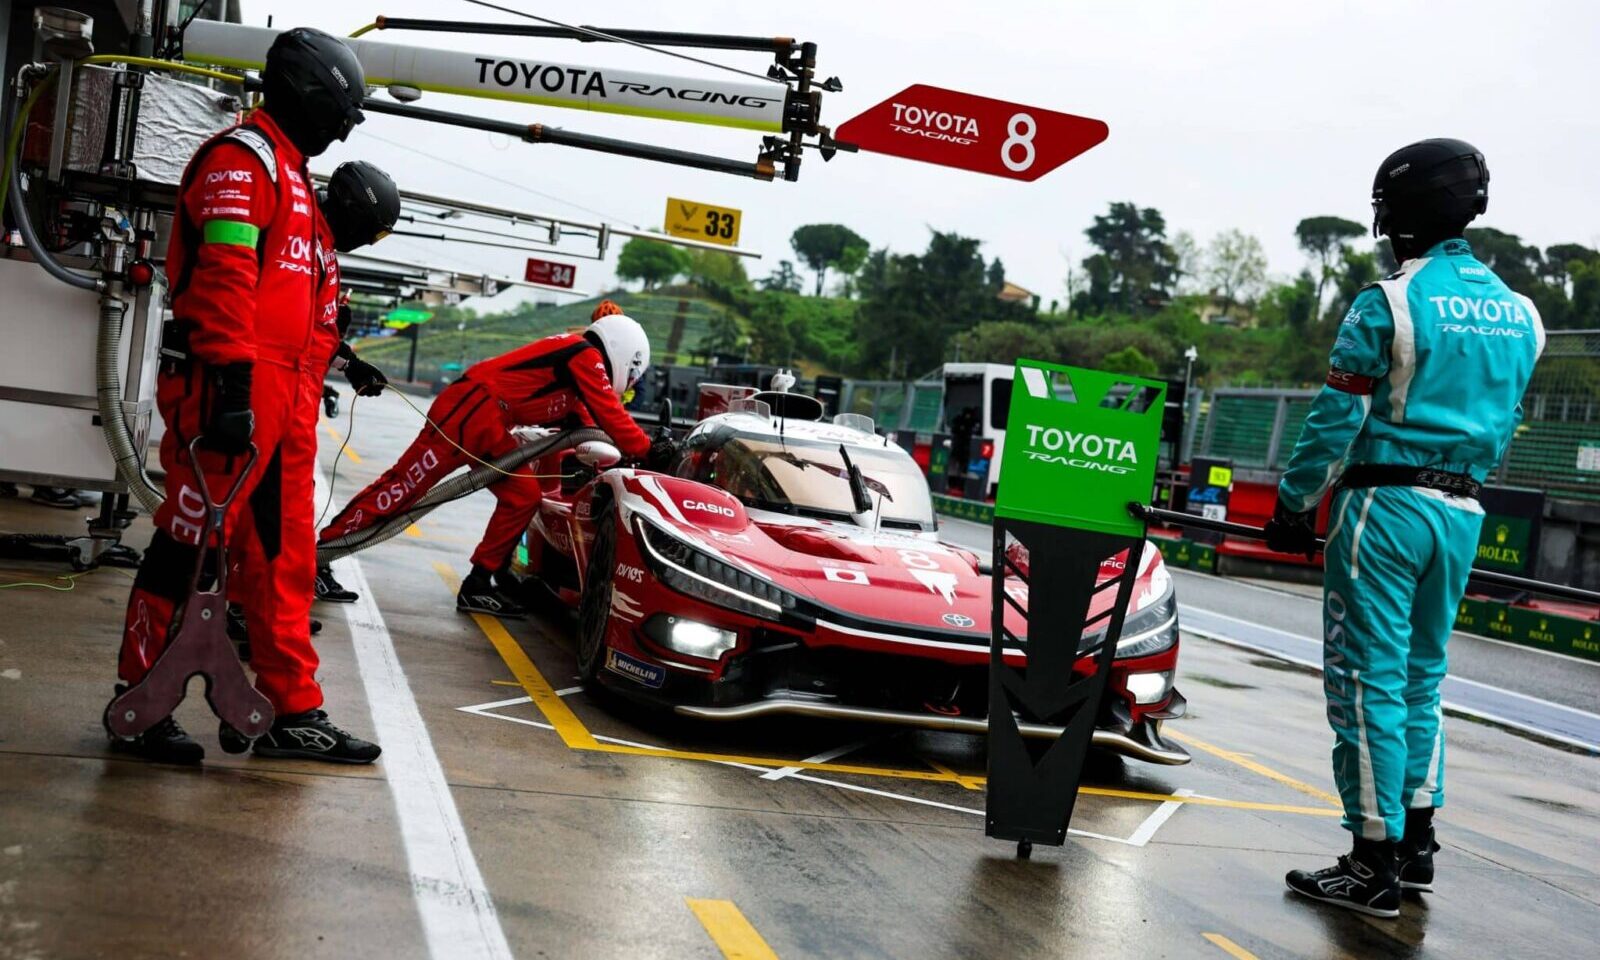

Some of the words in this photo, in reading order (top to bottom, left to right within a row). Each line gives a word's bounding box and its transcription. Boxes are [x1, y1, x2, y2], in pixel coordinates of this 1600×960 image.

[475, 57, 607, 98] TOYOTA
[608, 80, 782, 108] RACING
[892, 103, 980, 137] TOYOTA
[890, 123, 978, 145] RACING
[1001, 112, 1037, 172] 8
[705, 210, 735, 239] 33
[280, 235, 311, 261] TOY
[551, 265, 571, 286] 34
[1459, 267, 1486, 277] DENSO
[1429, 295, 1529, 328] TOYOTA
[1435, 323, 1530, 338] RACING
[1025, 424, 1138, 464] TOYOTA
[1022, 450, 1137, 475] RACING
[376, 448, 439, 511] DENSO
[682, 499, 735, 518] CASIO
[896, 549, 941, 571] 8
[1478, 545, 1520, 564] ROLEX
[617, 658, 658, 681] MICHELIN
[1325, 590, 1349, 728] DENSO
